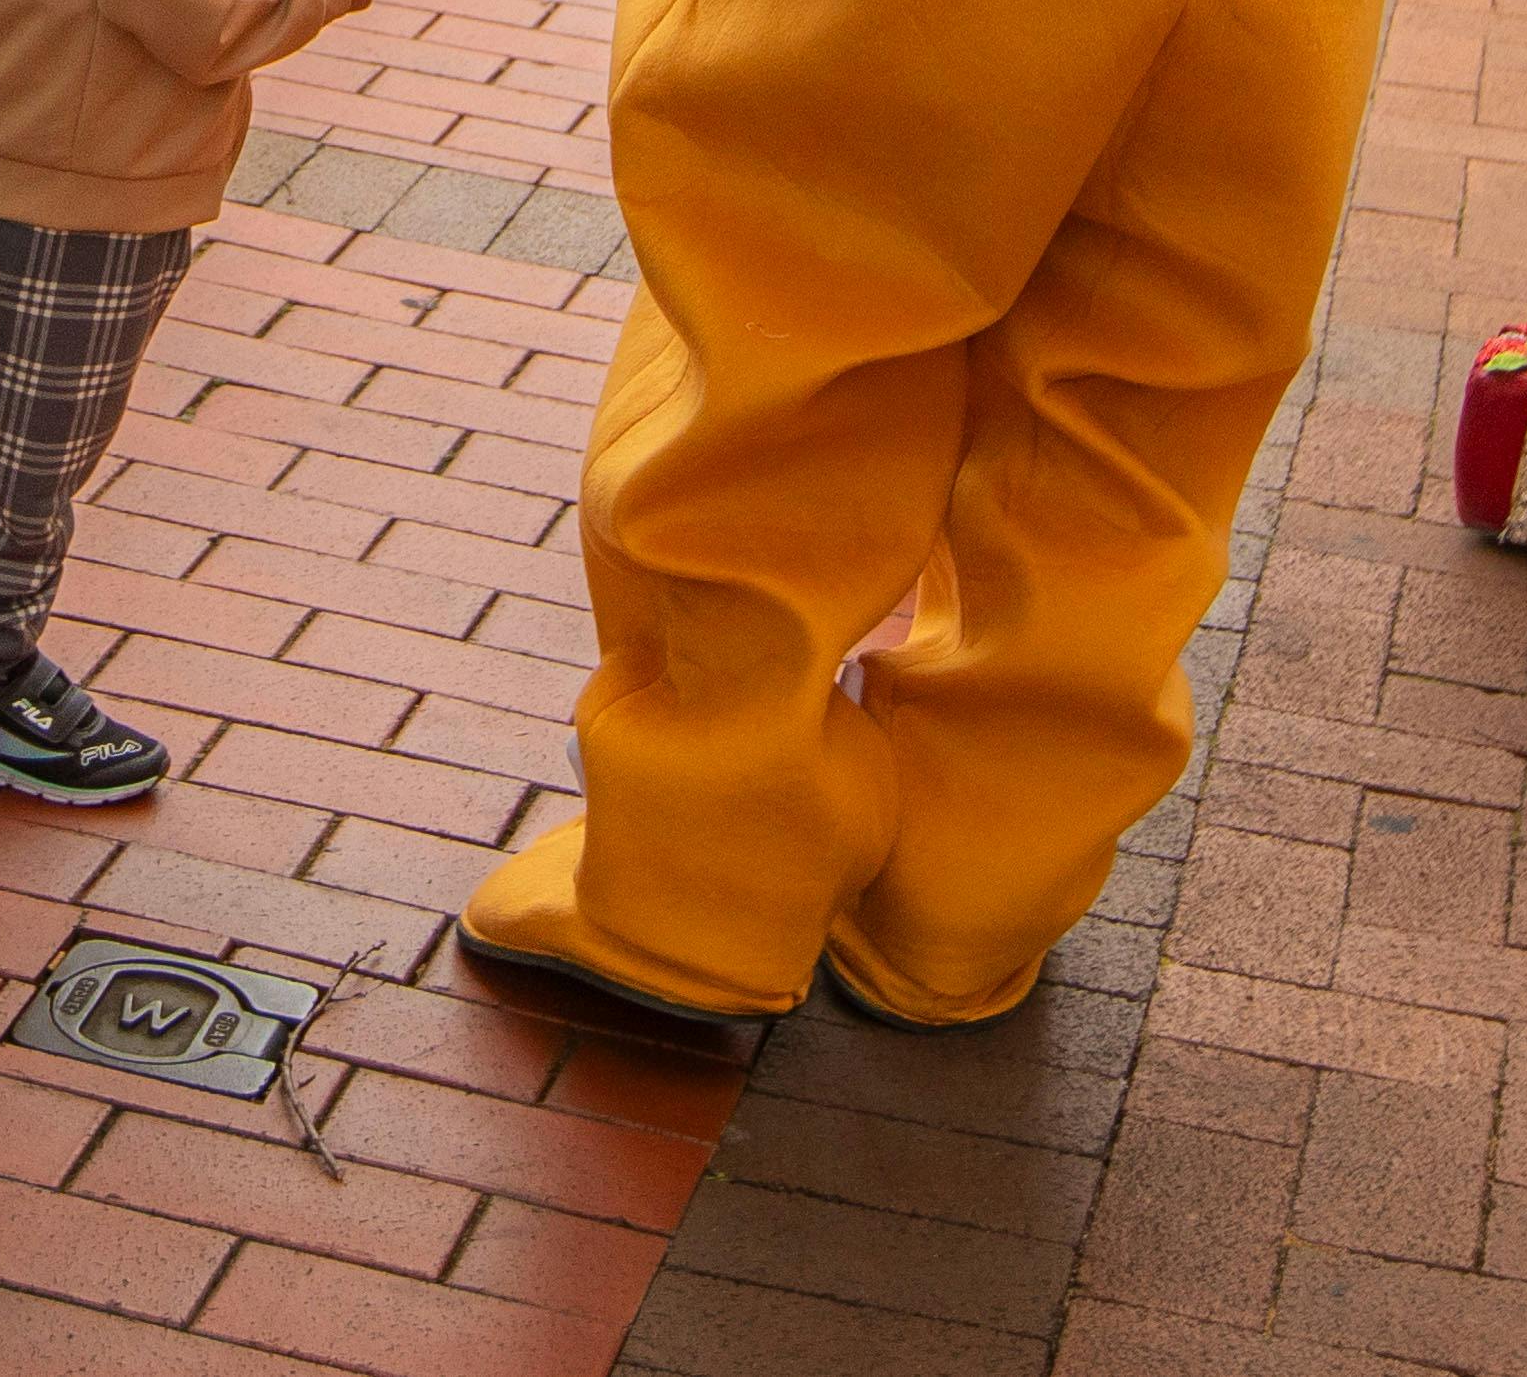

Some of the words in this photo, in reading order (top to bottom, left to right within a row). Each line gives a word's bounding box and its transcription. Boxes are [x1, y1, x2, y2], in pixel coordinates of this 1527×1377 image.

[11, 698, 54, 730] FILA
[80, 739, 143, 767] FILA
[118, 993, 194, 1039] W
